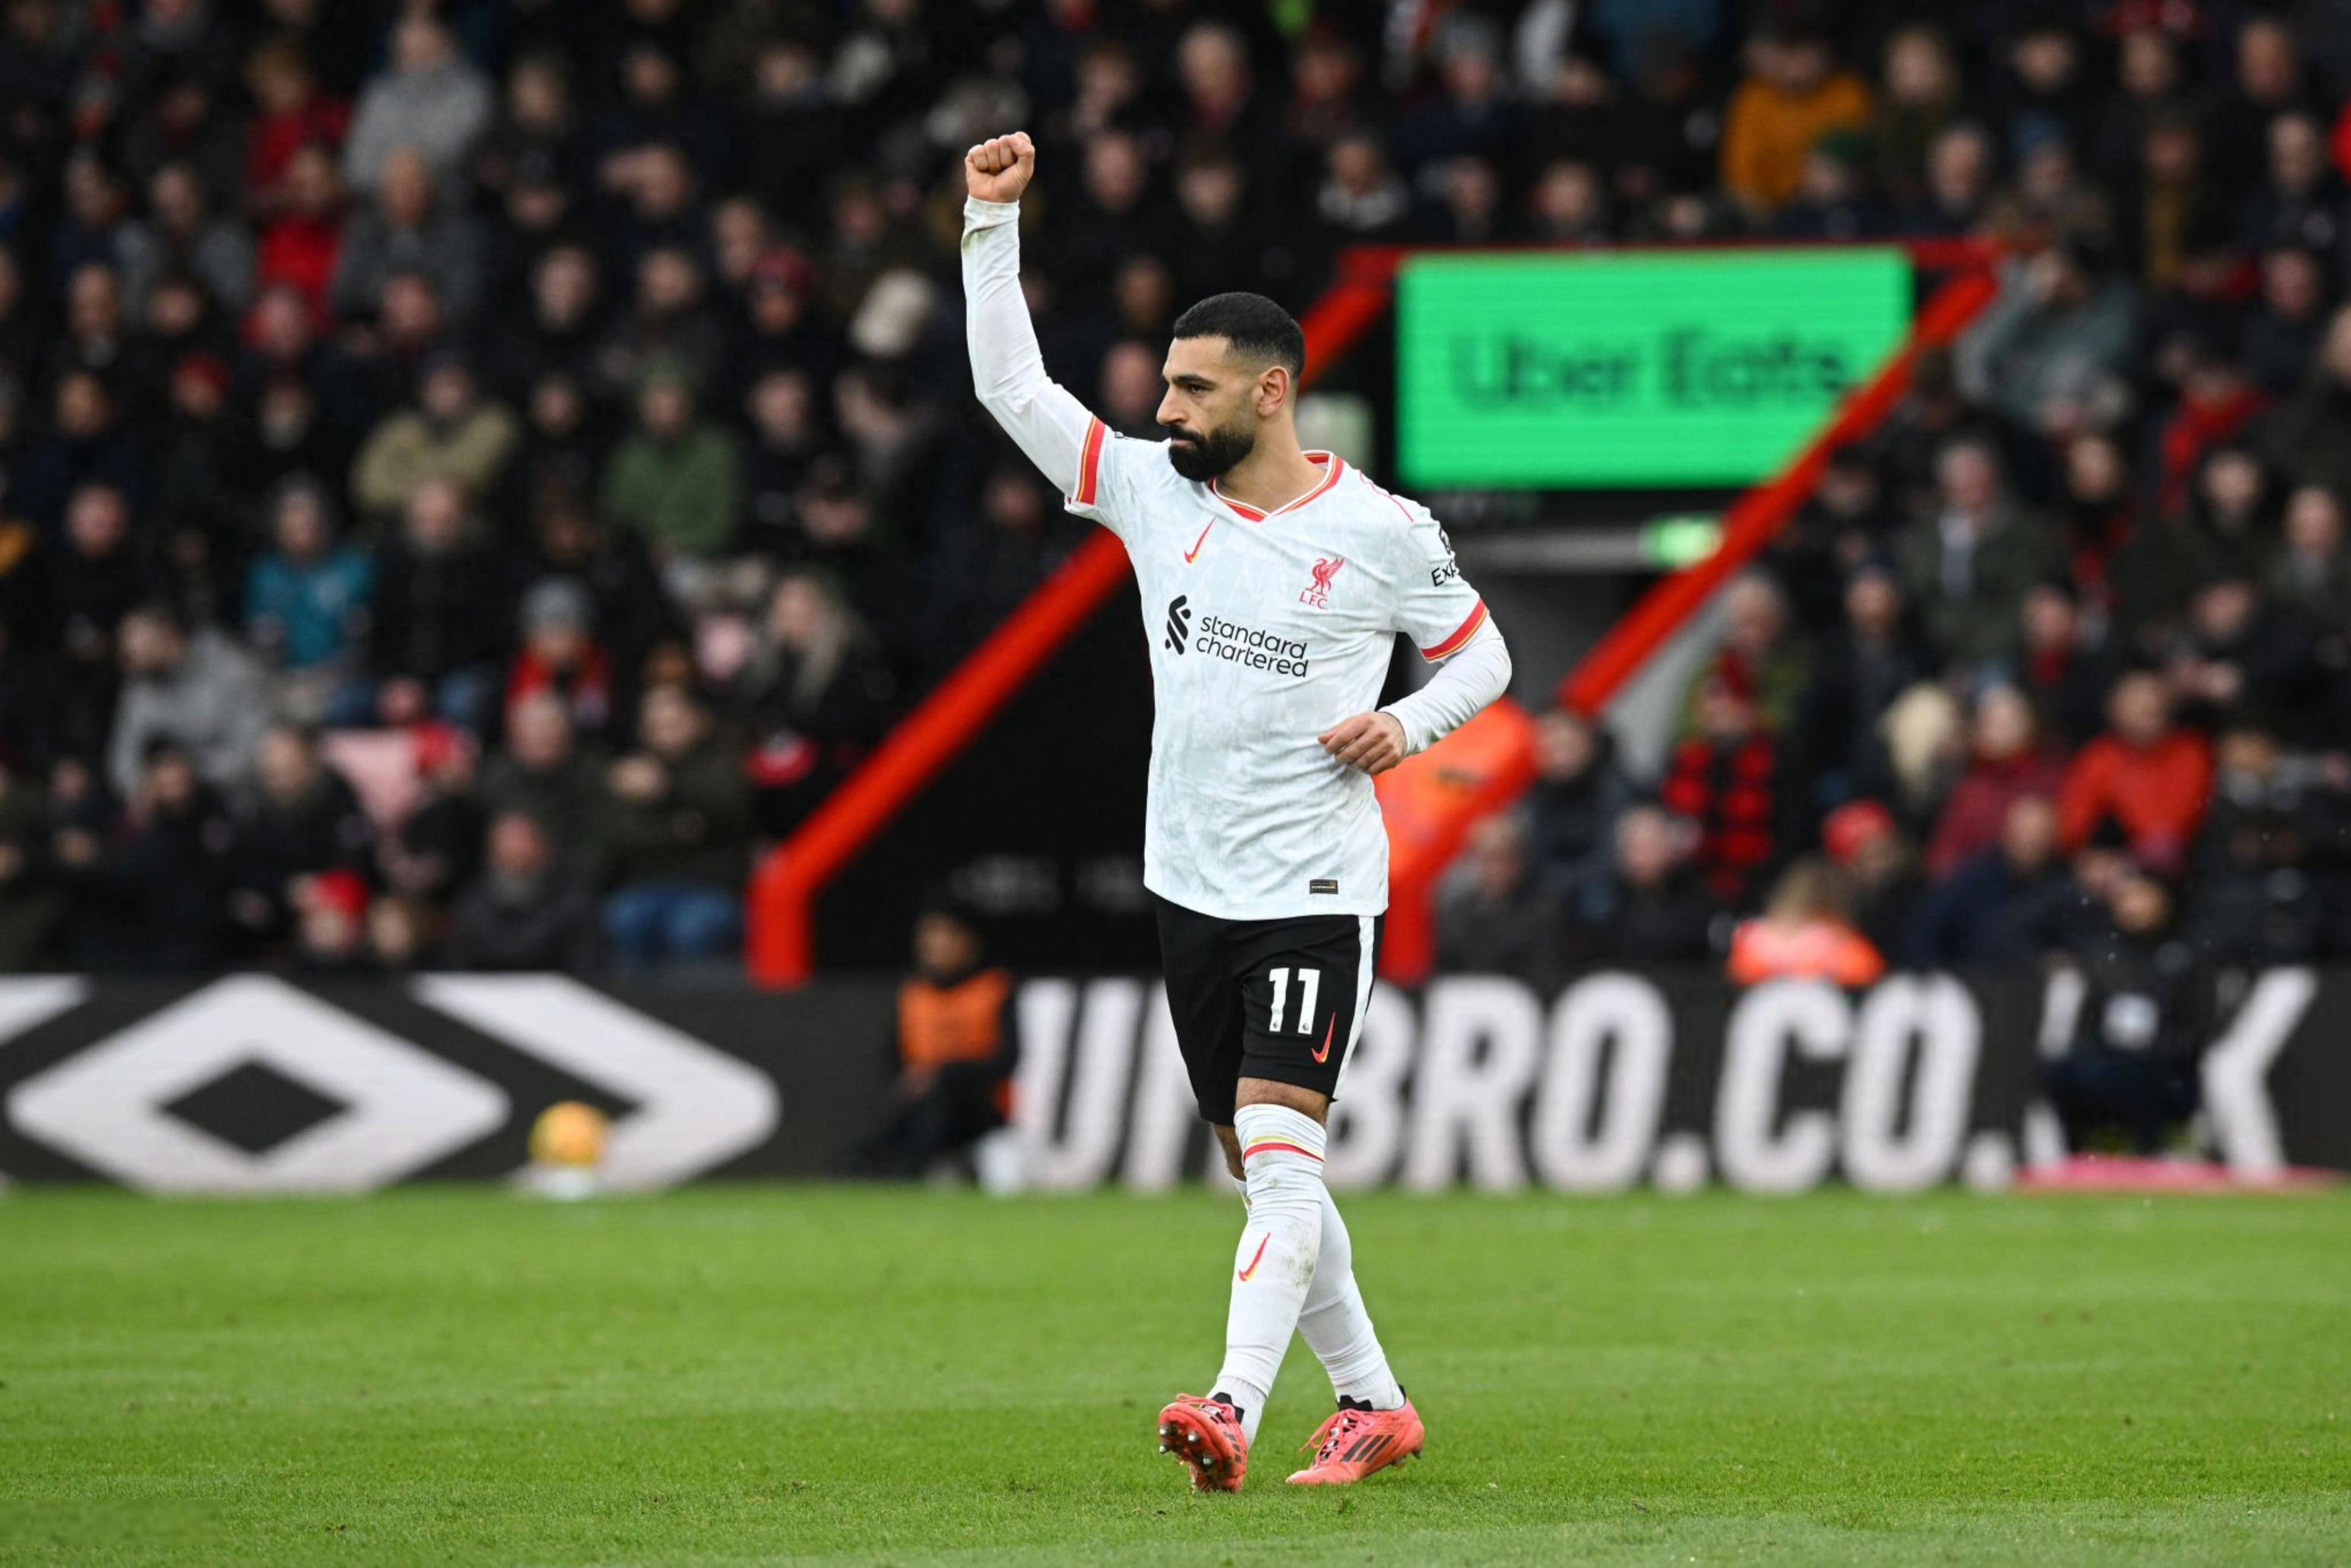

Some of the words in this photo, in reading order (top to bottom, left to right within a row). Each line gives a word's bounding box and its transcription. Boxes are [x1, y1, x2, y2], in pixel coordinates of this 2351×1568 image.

[1447, 327, 1639, 410] Uber
[1659, 323, 1846, 410] Eats
[1196, 636, 1309, 678] chartered
[1200, 616, 1308, 660] standard
[1269, 967, 1321, 1035] 11
